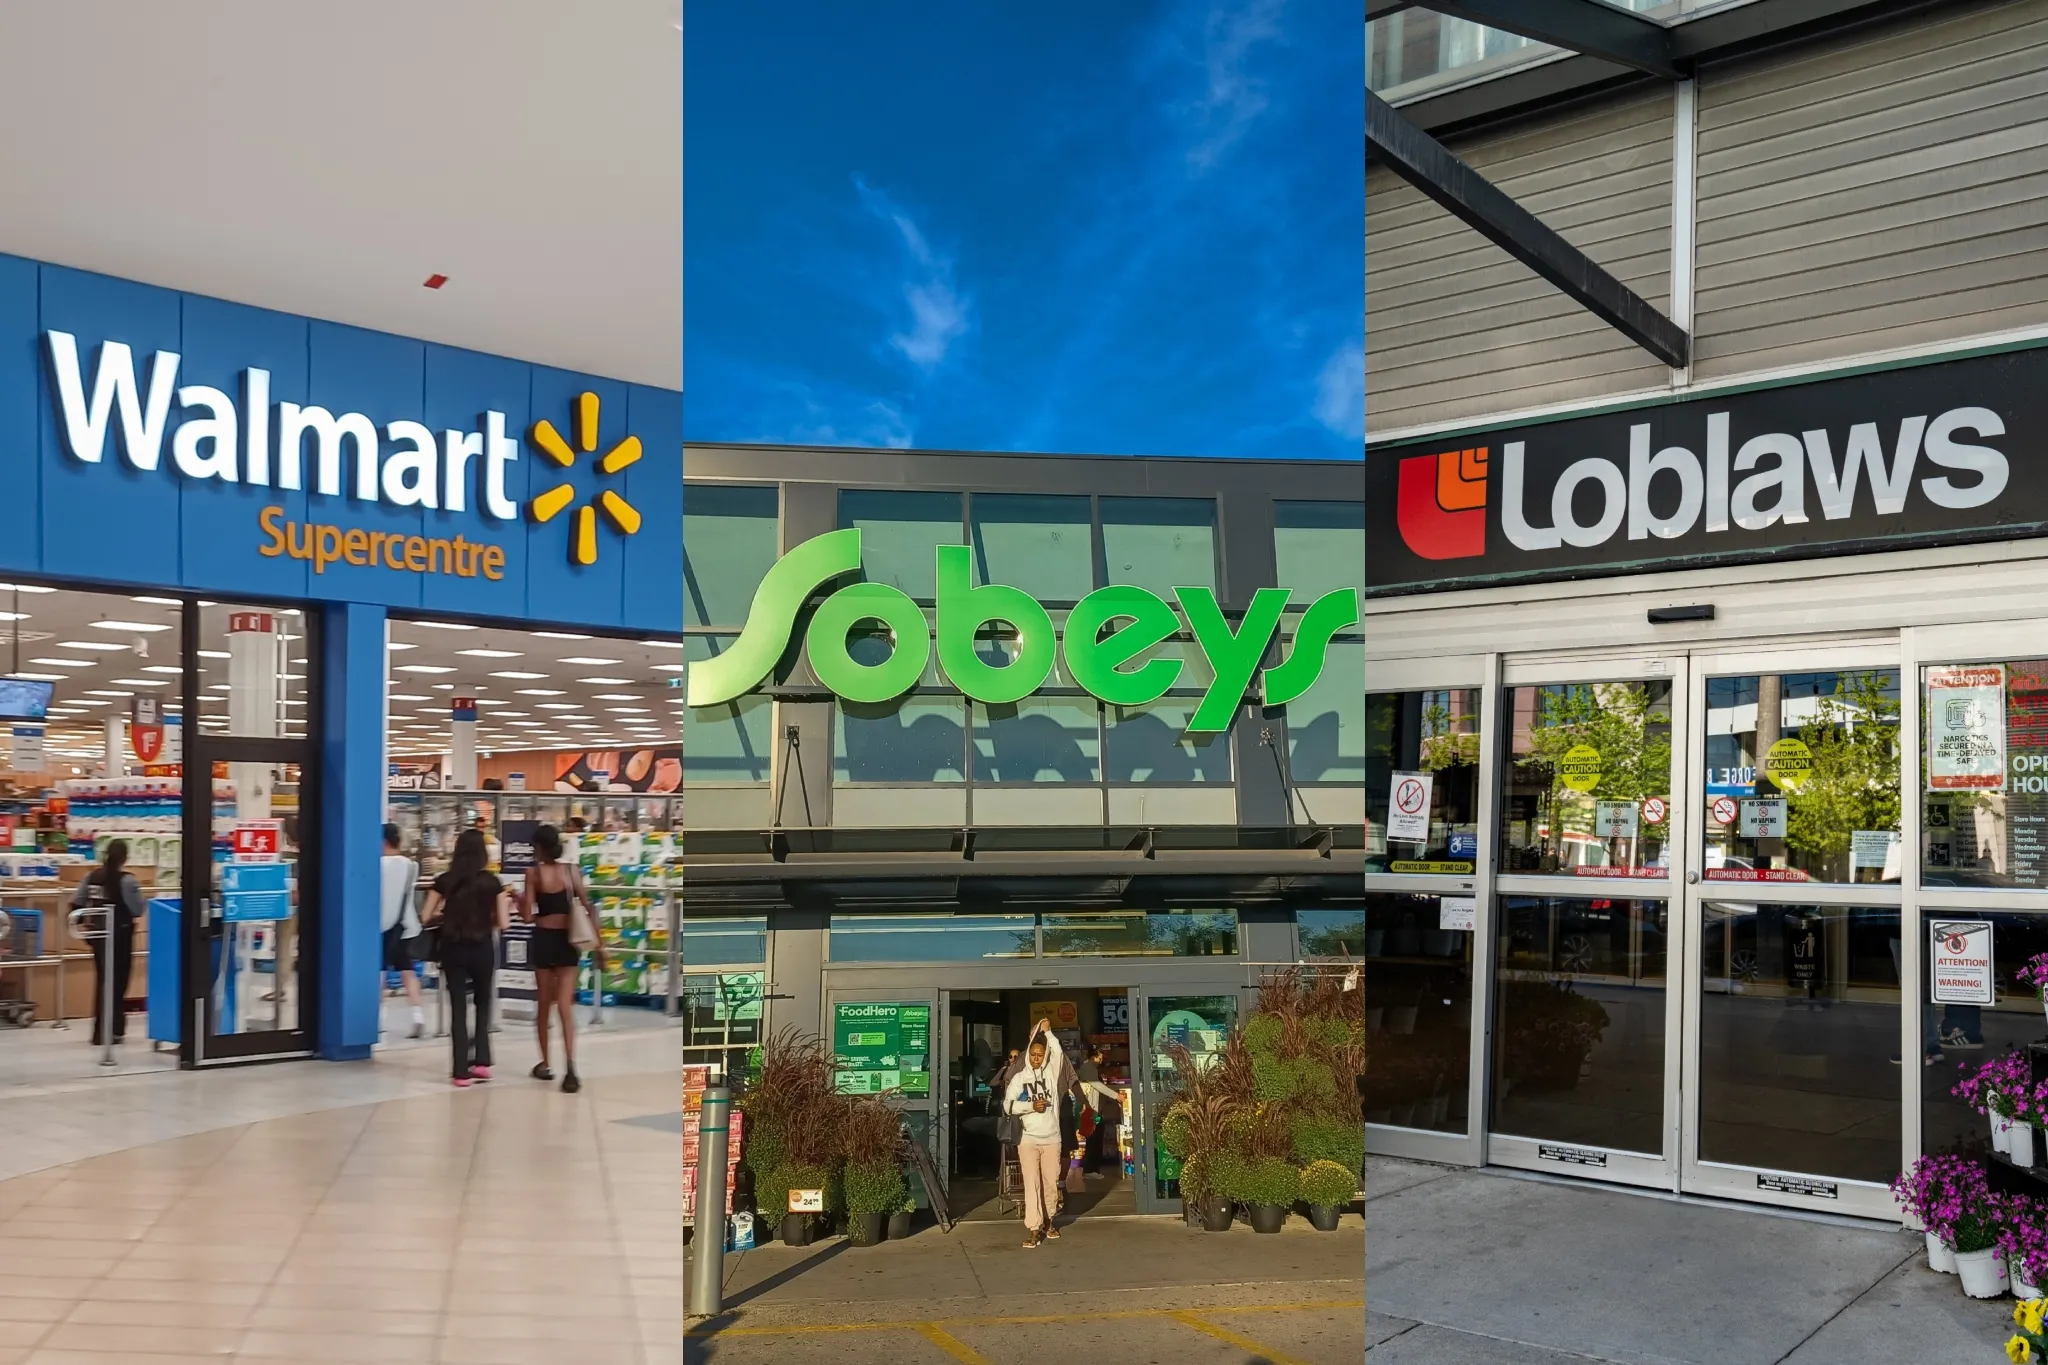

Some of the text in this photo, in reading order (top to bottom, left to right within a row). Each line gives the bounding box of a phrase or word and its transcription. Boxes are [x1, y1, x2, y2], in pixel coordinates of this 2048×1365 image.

[47, 329, 518, 520] Walmart
[1501, 406, 2010, 552] Loblaws
[258, 506, 505, 580] Supercentre
[687, 527, 1359, 733] Sobeys
[1935, 673, 1995, 686] ATTENTION
[2010, 673, 2041, 691] NO
[1940, 742, 1975, 750] SECURED
[1769, 750, 1808, 758] AUTOMATIC
[1937, 749, 1996, 757] TIME-DELAYED
[1563, 764, 1600, 774] CAUTION
[1767, 760, 1810, 770] CAUTION
[387, 774, 423, 789] akery
[2014, 828, 2037, 836] Monday
[2014, 836, 2037, 844] Tuesday
[2014, 844, 2046, 852] Wednesday
[2014, 852, 2040, 860] Thursday
[1394, 862, 1418, 870] AUTOMATIC
[1440, 863, 1453, 871] STAND
[1577, 867, 1606, 875] AUTOMATIC
[1607, 868, 1622, 876] DOOR
[1646, 869, 1664, 877] CLEAR
[1709, 870, 1805, 880] AUTOMATIC DOOR STAND CLEAR
[1938, 958, 1988, 967] ATTENTION!
[1938, 978, 1982, 988] WARNING!
[839, 1005, 897, 1017] FoodHero
[1023, 1078, 1047, 1095] IVY
[1026, 1088, 1052, 1103] PARK
